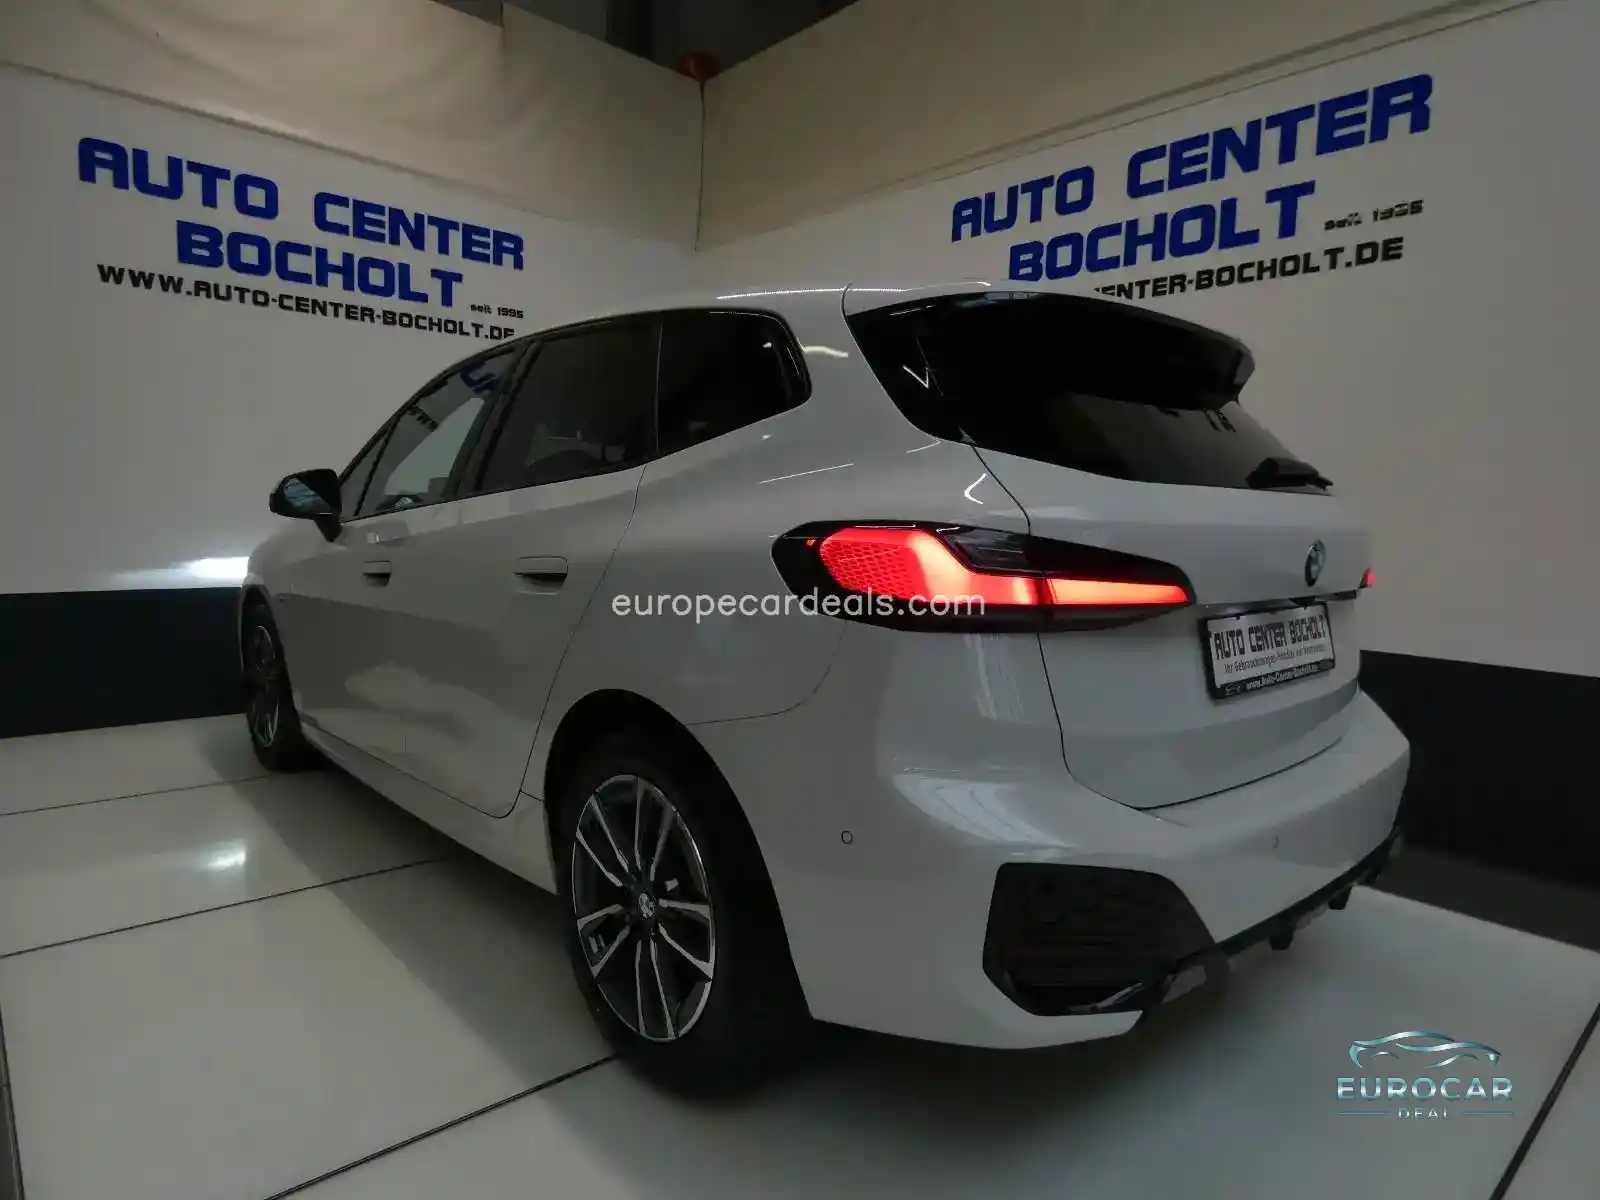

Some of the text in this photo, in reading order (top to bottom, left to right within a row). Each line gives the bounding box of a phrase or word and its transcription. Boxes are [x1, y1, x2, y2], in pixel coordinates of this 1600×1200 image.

[78, 137, 524, 270] AUTO CENTER
[951, 74, 1433, 243] AUTO CENTER
[177, 220, 463, 308] BOCHOLT
[1008, 181, 1315, 283] BOCHOLT
[1093, 236, 1405, 301] ENTER-BOCHOLT.DE
[1213, 629, 1246, 661] AUTO
[1248, 622, 1288, 653] CENTER
[1288, 614, 1326, 645] BOCHOLT
